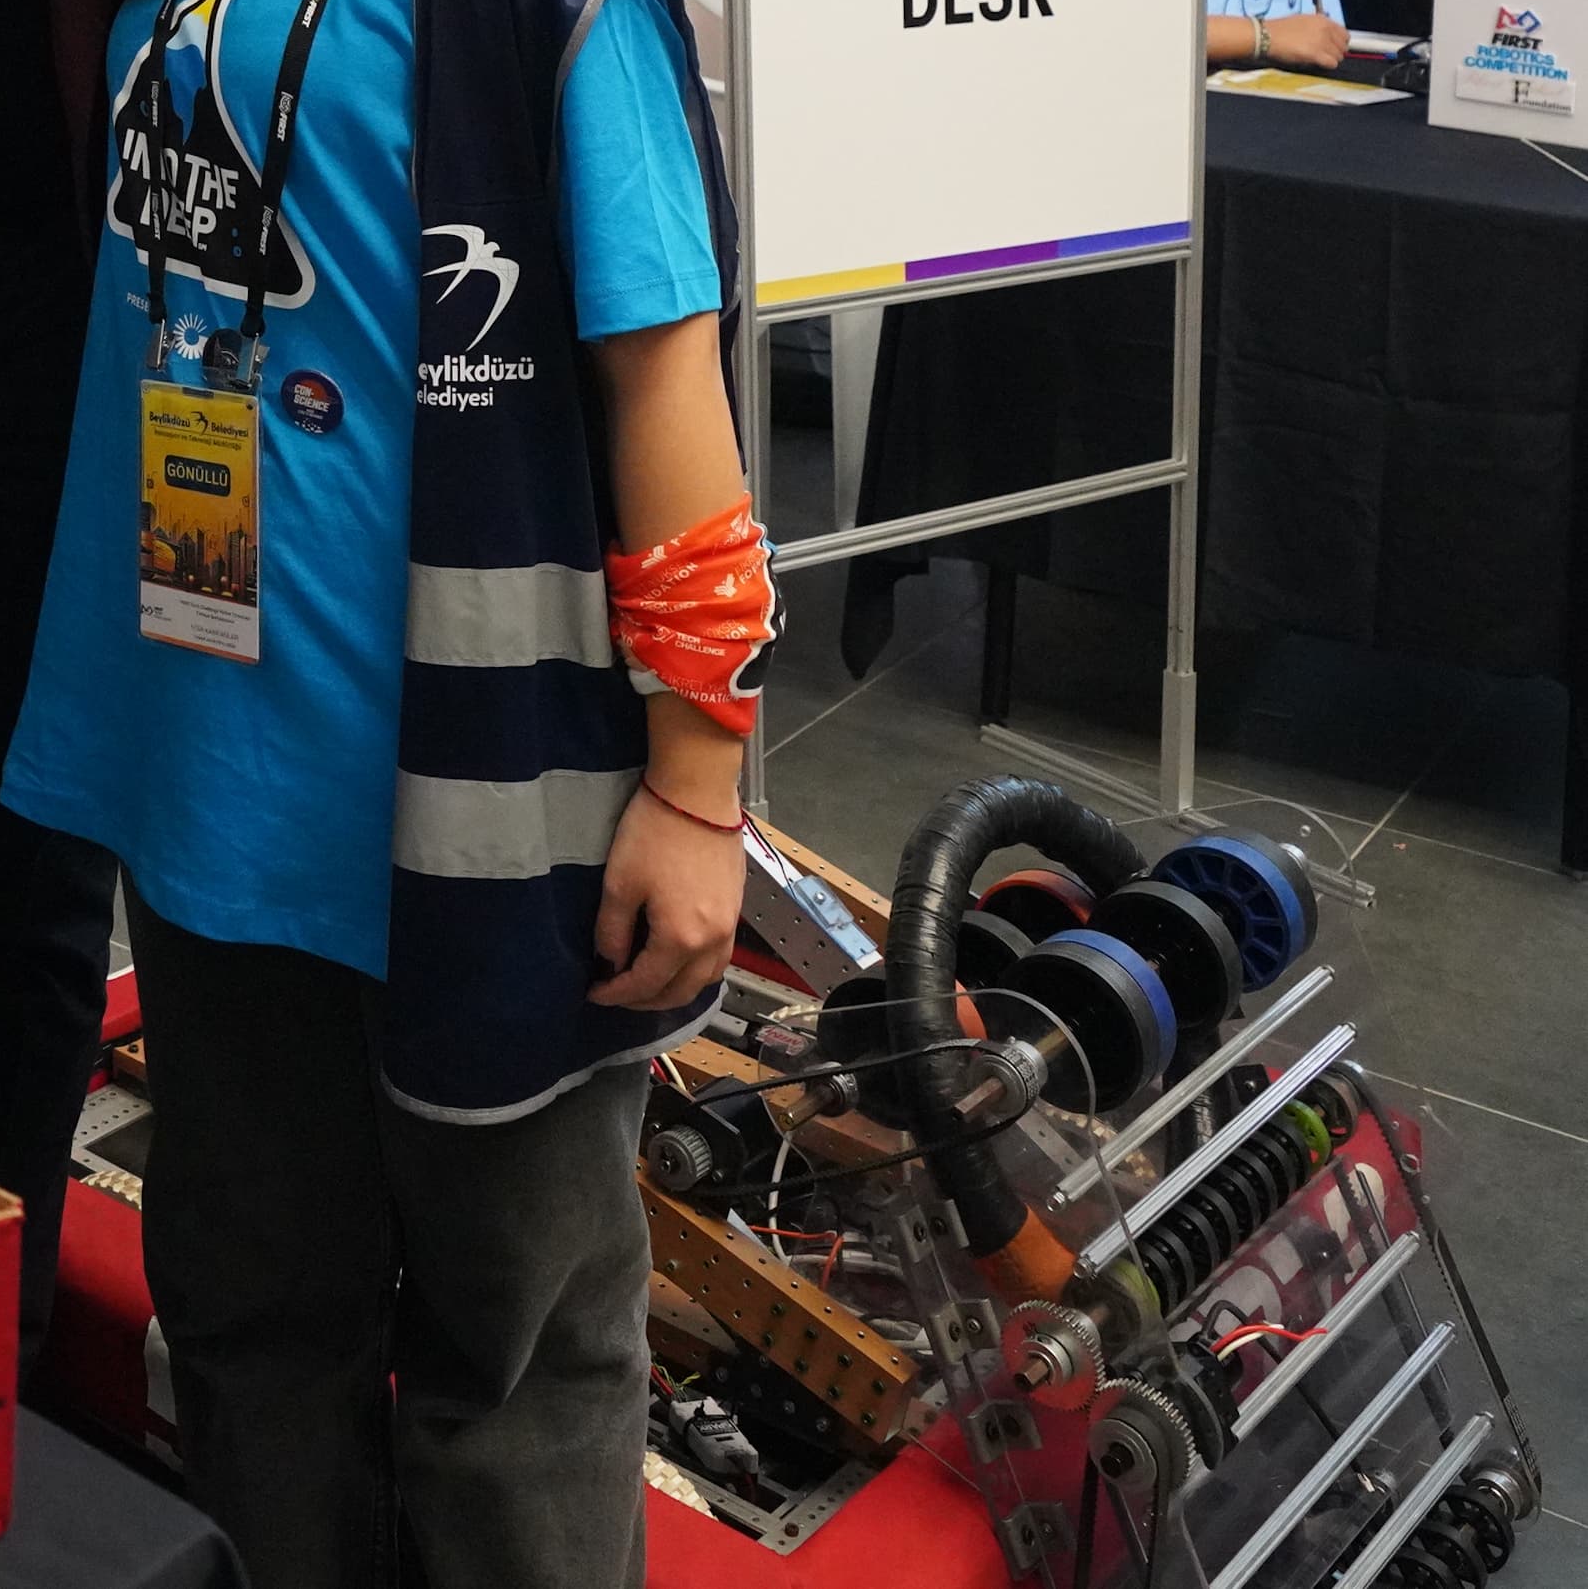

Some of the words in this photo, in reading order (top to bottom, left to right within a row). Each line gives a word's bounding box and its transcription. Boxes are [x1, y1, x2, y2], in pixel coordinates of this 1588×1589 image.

[301, 0, 318, 28] FIRST
[1492, 33, 1543, 50] FIRST
[1464, 56, 1568, 81] COMPETITION
[1478, 45, 1554, 66] ROBOTICS
[277, 110, 289, 142] FIRST
[184, 153, 240, 214] THE
[417, 354, 535, 389] eylikdüzü
[293, 394, 330, 413] SCIENCE
[294, 384, 314, 397] CON-
[416, 385, 494, 412] elediyesi
[149, 411, 191, 428] Beylikdüzü
[210, 422, 249, 438] Belediyesi
[166, 461, 229, 488] GÖNÜLLÜ
[675, 632, 700, 644] TECH
[675, 642, 726, 656] CHALLENGE
